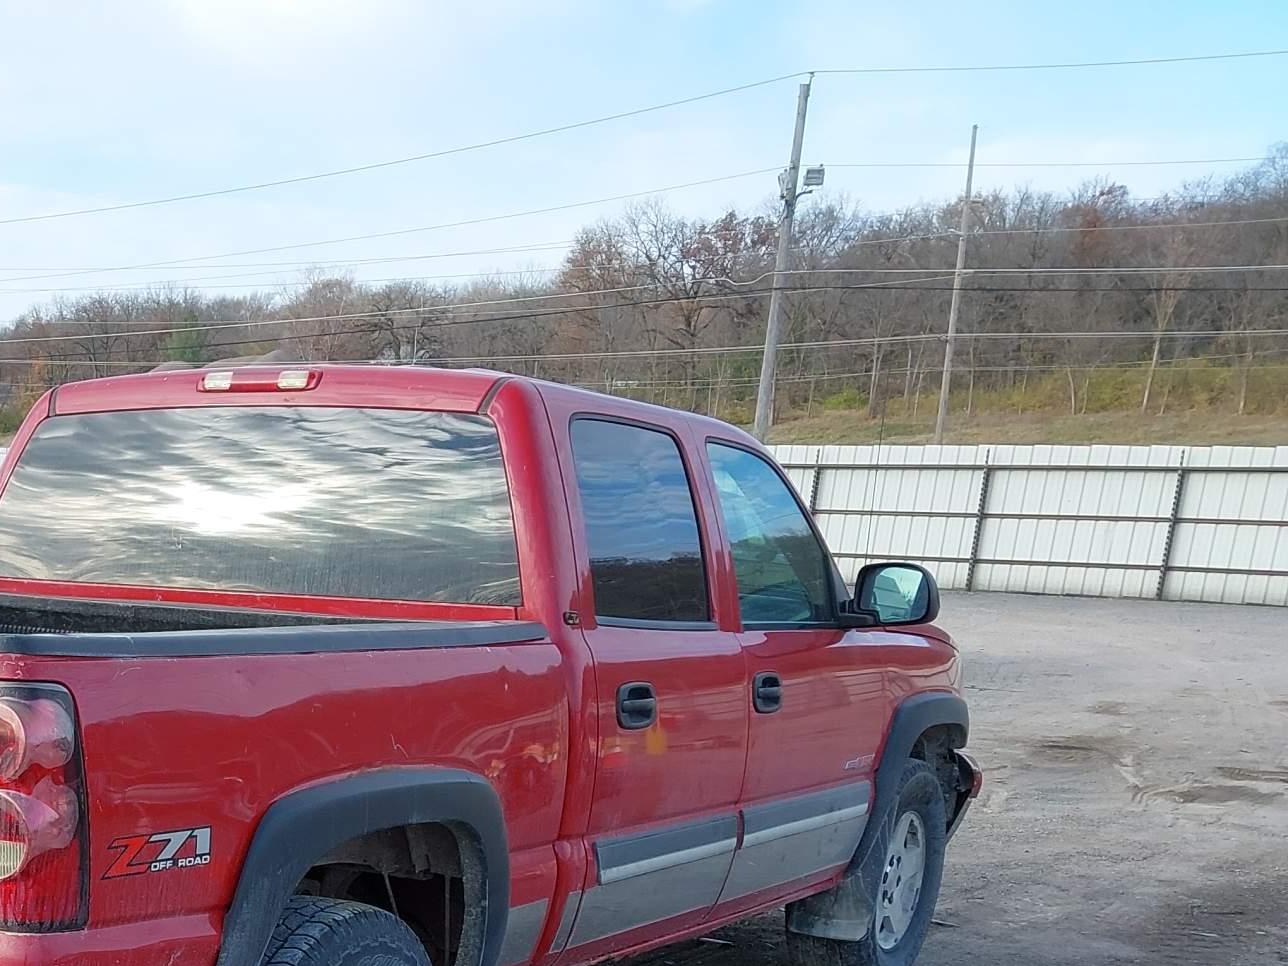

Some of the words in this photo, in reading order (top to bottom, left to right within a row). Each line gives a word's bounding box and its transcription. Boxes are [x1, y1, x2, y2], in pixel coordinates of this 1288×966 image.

[100, 825, 212, 880] Z71
[151, 861, 173, 871] OFF
[178, 856, 210, 867] ROAD
